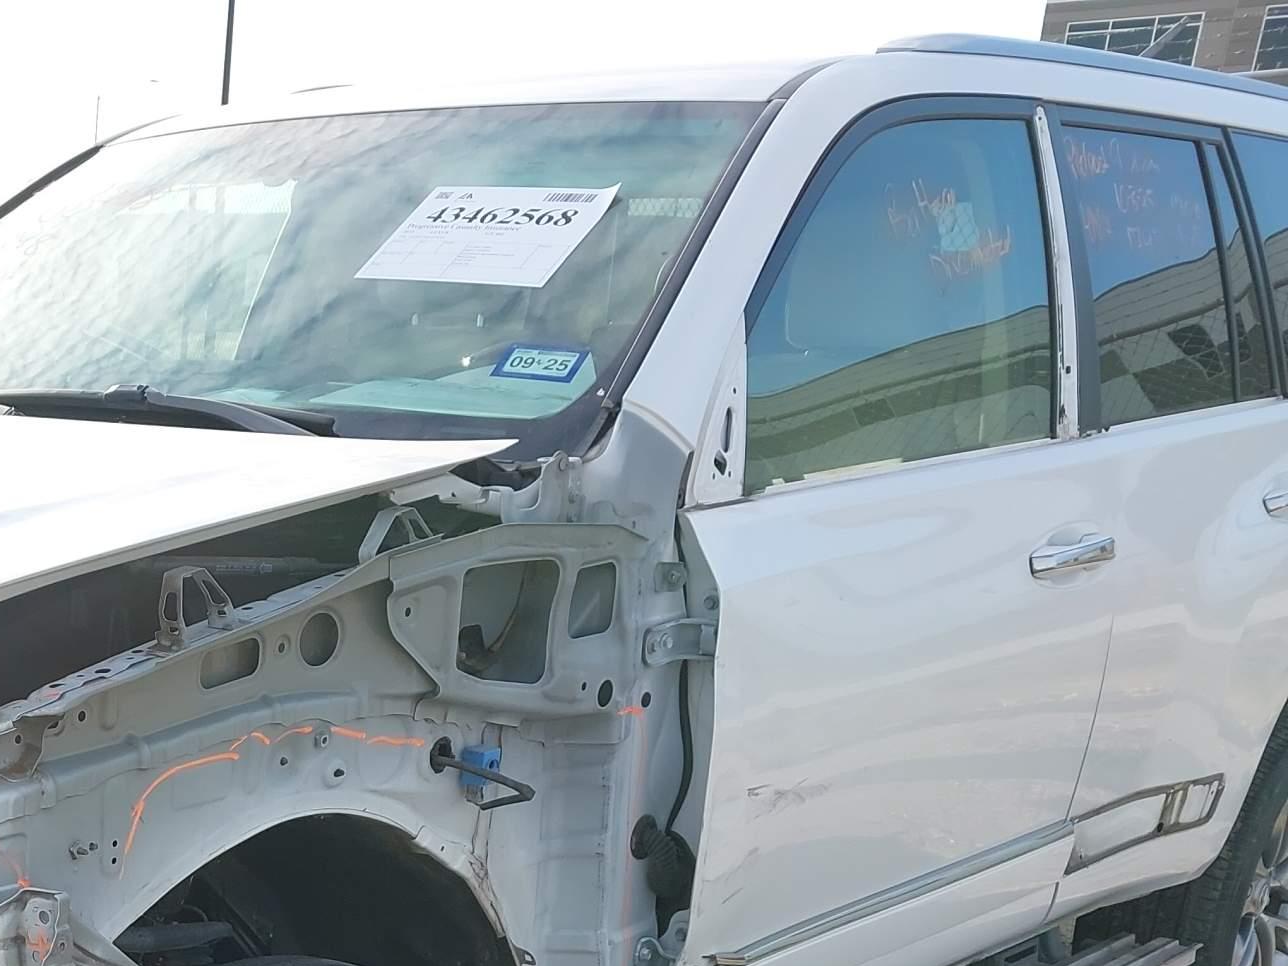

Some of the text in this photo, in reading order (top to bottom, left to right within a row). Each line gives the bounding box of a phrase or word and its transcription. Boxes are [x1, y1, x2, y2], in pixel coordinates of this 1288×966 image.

[426, 206, 579, 227] 43462568
[510, 355, 571, 372] 09 25
